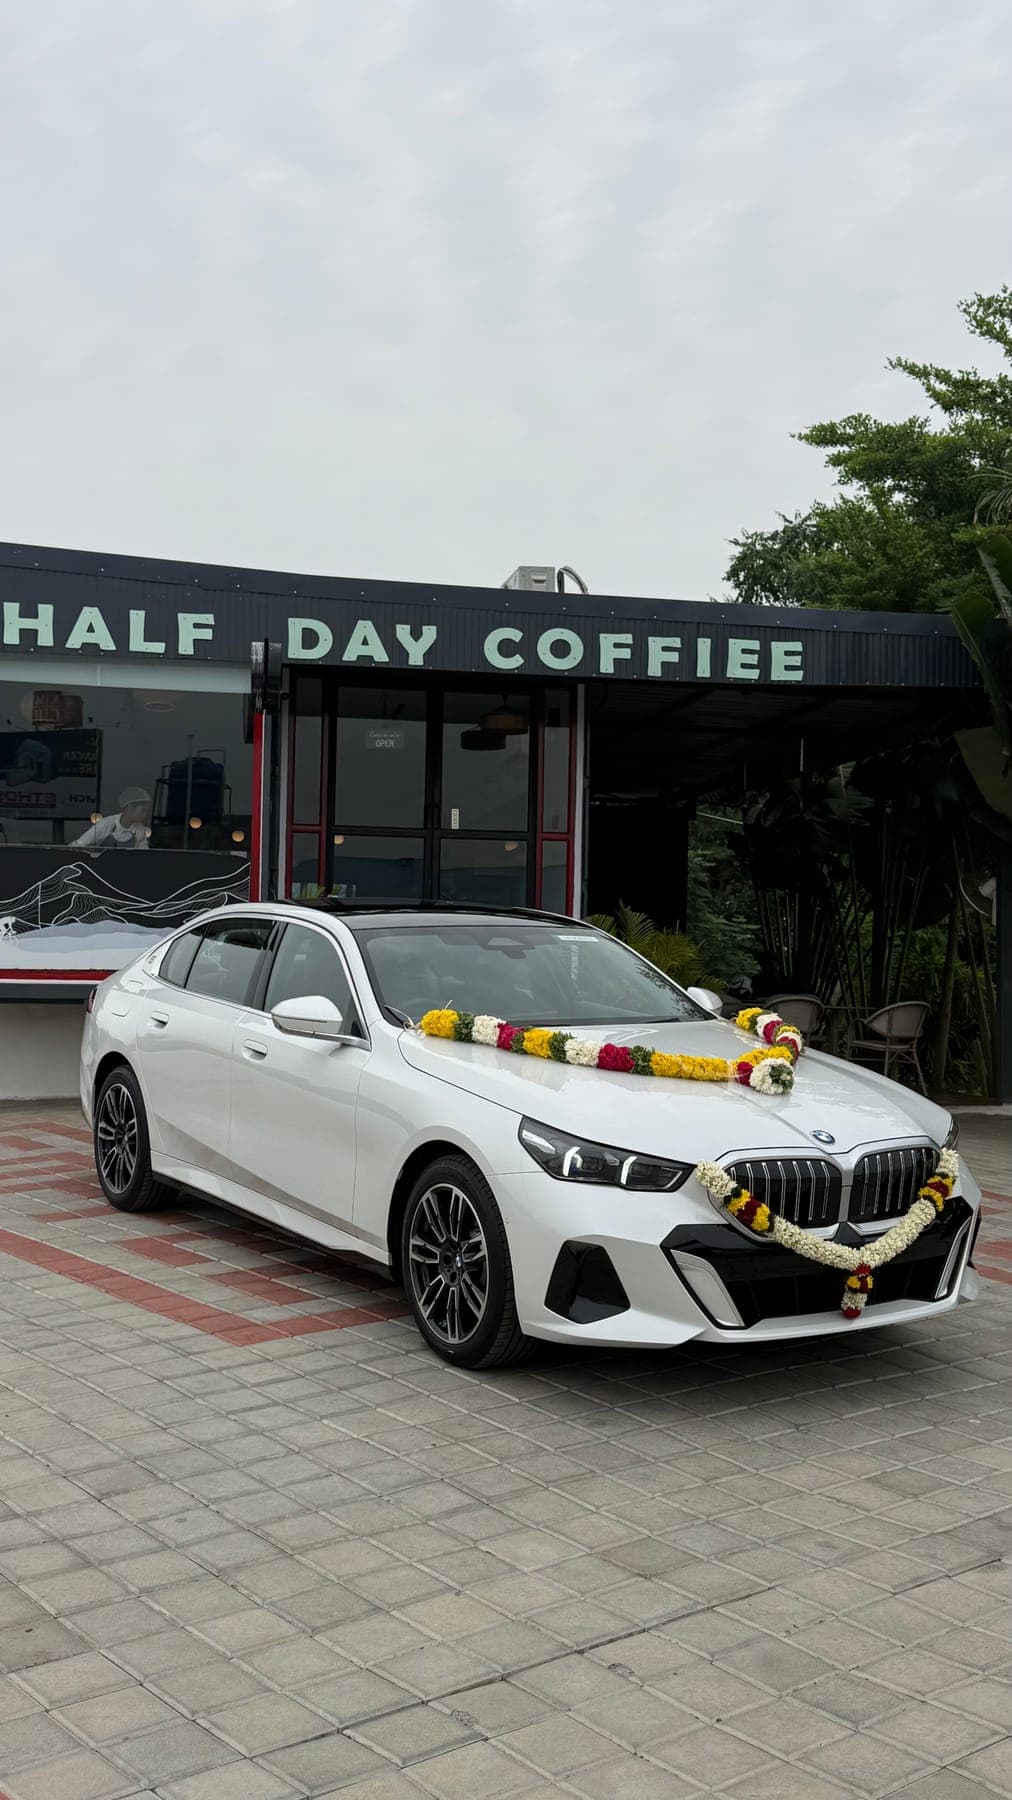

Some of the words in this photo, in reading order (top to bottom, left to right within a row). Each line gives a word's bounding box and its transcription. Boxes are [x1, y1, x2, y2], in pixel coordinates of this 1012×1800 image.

[3, 602, 215, 655] HALF
[288, 617, 437, 666] DAY
[483, 627, 804, 682] COFFIEE
